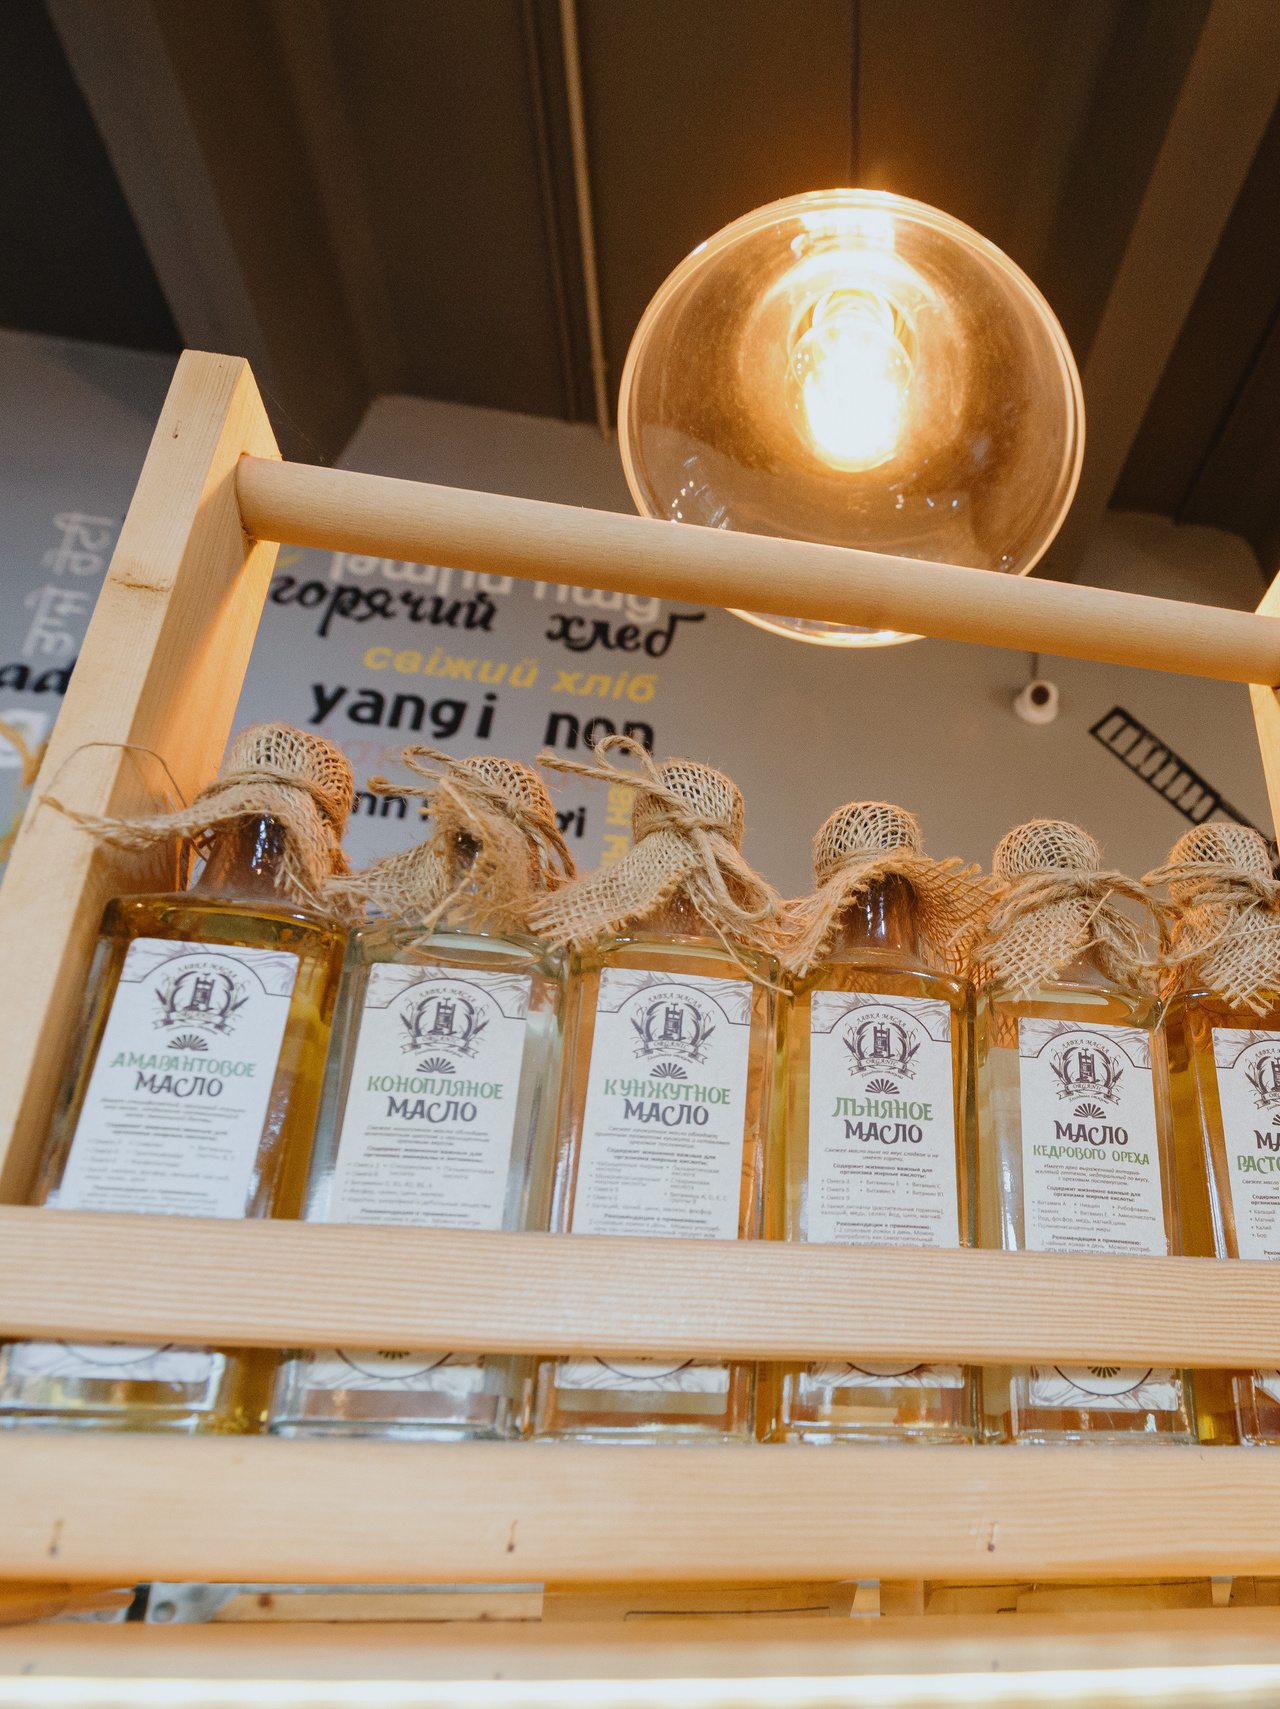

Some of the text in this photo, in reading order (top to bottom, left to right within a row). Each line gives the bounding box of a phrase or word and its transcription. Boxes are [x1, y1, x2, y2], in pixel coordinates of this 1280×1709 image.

[271, 576, 498, 637] горячий
[545, 612, 706, 658] хлеб
[363, 645, 659, 702] свіжий хліб
[308, 682, 655, 756] yangi non
[110, 1052, 256, 1078] АМАРАНТОВОЕ
[134, 1071, 223, 1098] МАСЛО
[366, 1075, 503, 1100] КОНОПЛЯНОЕ
[603, 1078, 731, 1105] КУНЖУТНОЕ
[386, 1096, 478, 1123] МАСЛО
[623, 1098, 709, 1127] МАСЛО
[831, 1096, 934, 1121] ЛЬНЯНОЕ
[843, 1119, 923, 1145] МАСЛО
[1053, 1120, 1129, 1146] МАСЛО
[1032, 1144, 1150, 1165] КЕДРОВОГО ОРЕХА
